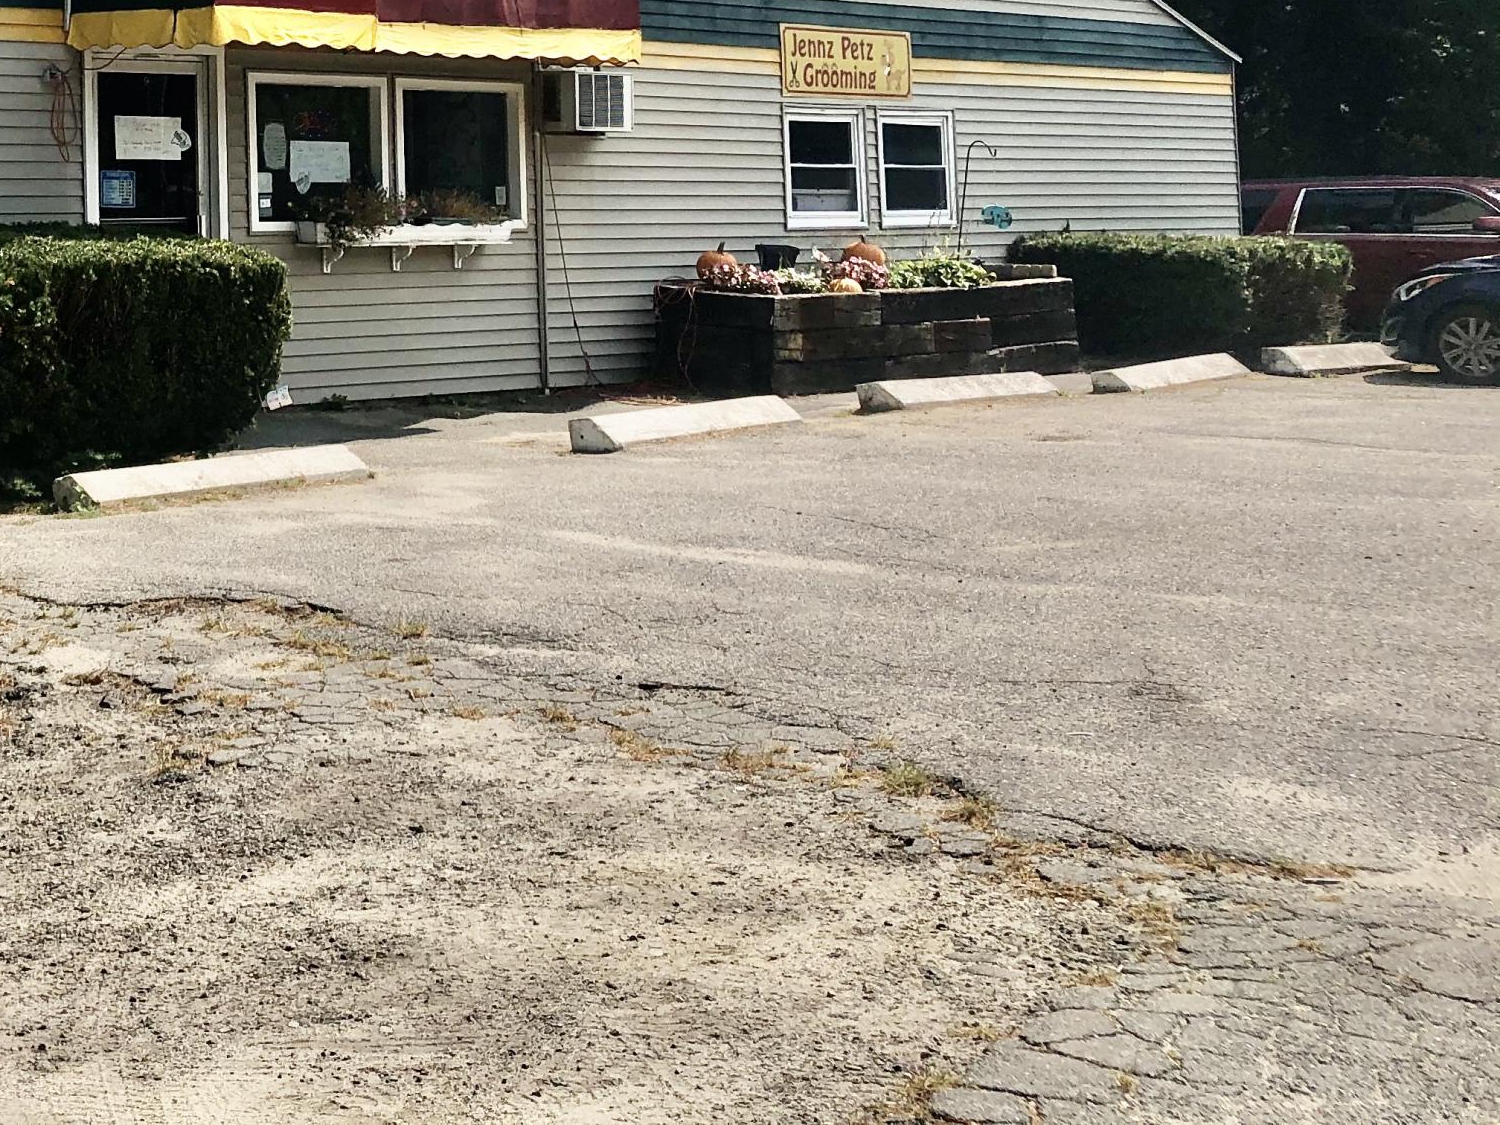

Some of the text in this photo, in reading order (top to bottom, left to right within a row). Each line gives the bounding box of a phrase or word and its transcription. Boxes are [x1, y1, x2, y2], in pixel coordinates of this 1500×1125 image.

[791, 33, 874, 61] Jennz Petz
[803, 62, 877, 90] Grooming
